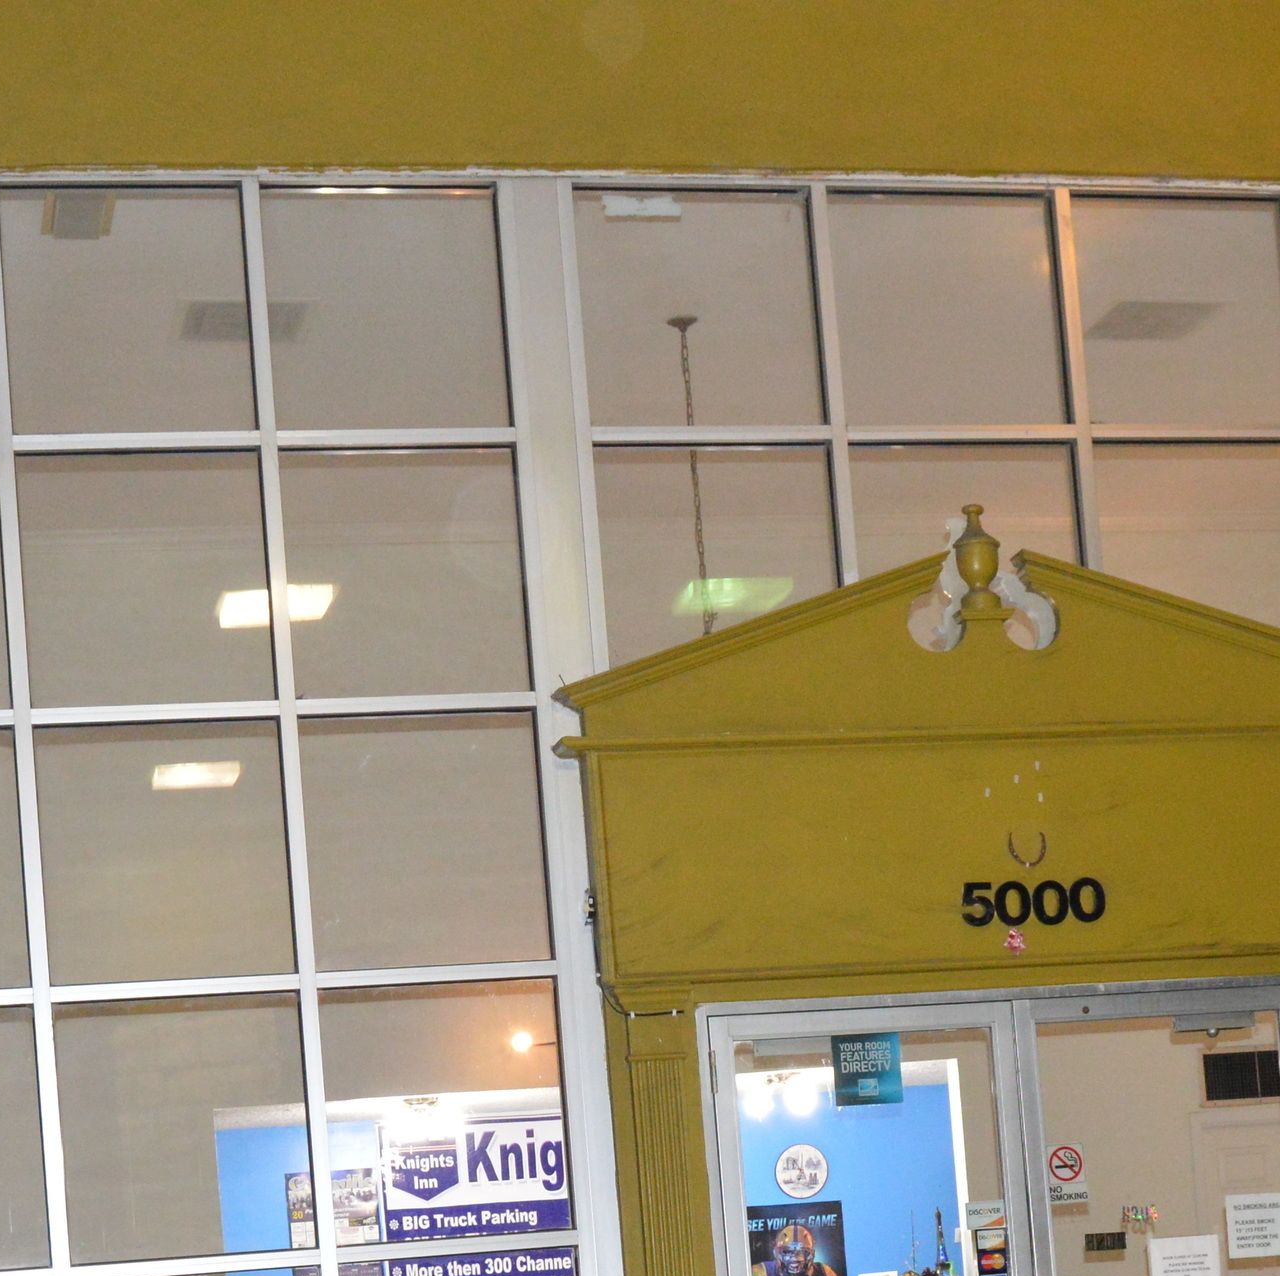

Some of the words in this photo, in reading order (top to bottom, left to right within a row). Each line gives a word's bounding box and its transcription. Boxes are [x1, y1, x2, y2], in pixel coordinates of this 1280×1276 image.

[961, 877, 1106, 927] 5000
[839, 1042, 863, 1052] YOUR
[865, 1041, 891, 1050] ROOM
[840, 1050, 891, 1062] FEATURES
[841, 1060, 891, 1073] DIRECTV
[395, 1154, 454, 1172] Knights
[465, 1129, 564, 1192] Knig
[413, 1176, 438, 1189] Inn
[1049, 1186, 1063, 1194] NO
[1050, 1191, 1089, 1202] SMOKING
[968, 1207, 1001, 1216] DISCOVER
[402, 1215, 430, 1231] BIG
[433, 1211, 478, 1228] Truck
[481, 1208, 538, 1226] Parking
[747, 1219, 765, 1232] SEE
[767, 1217, 787, 1231] YOU
[808, 1214, 838, 1227] GAME
[447, 1260, 481, 1276] then
[484, 1257, 512, 1275] 300
[516, 1255, 572, 1272] Channe
